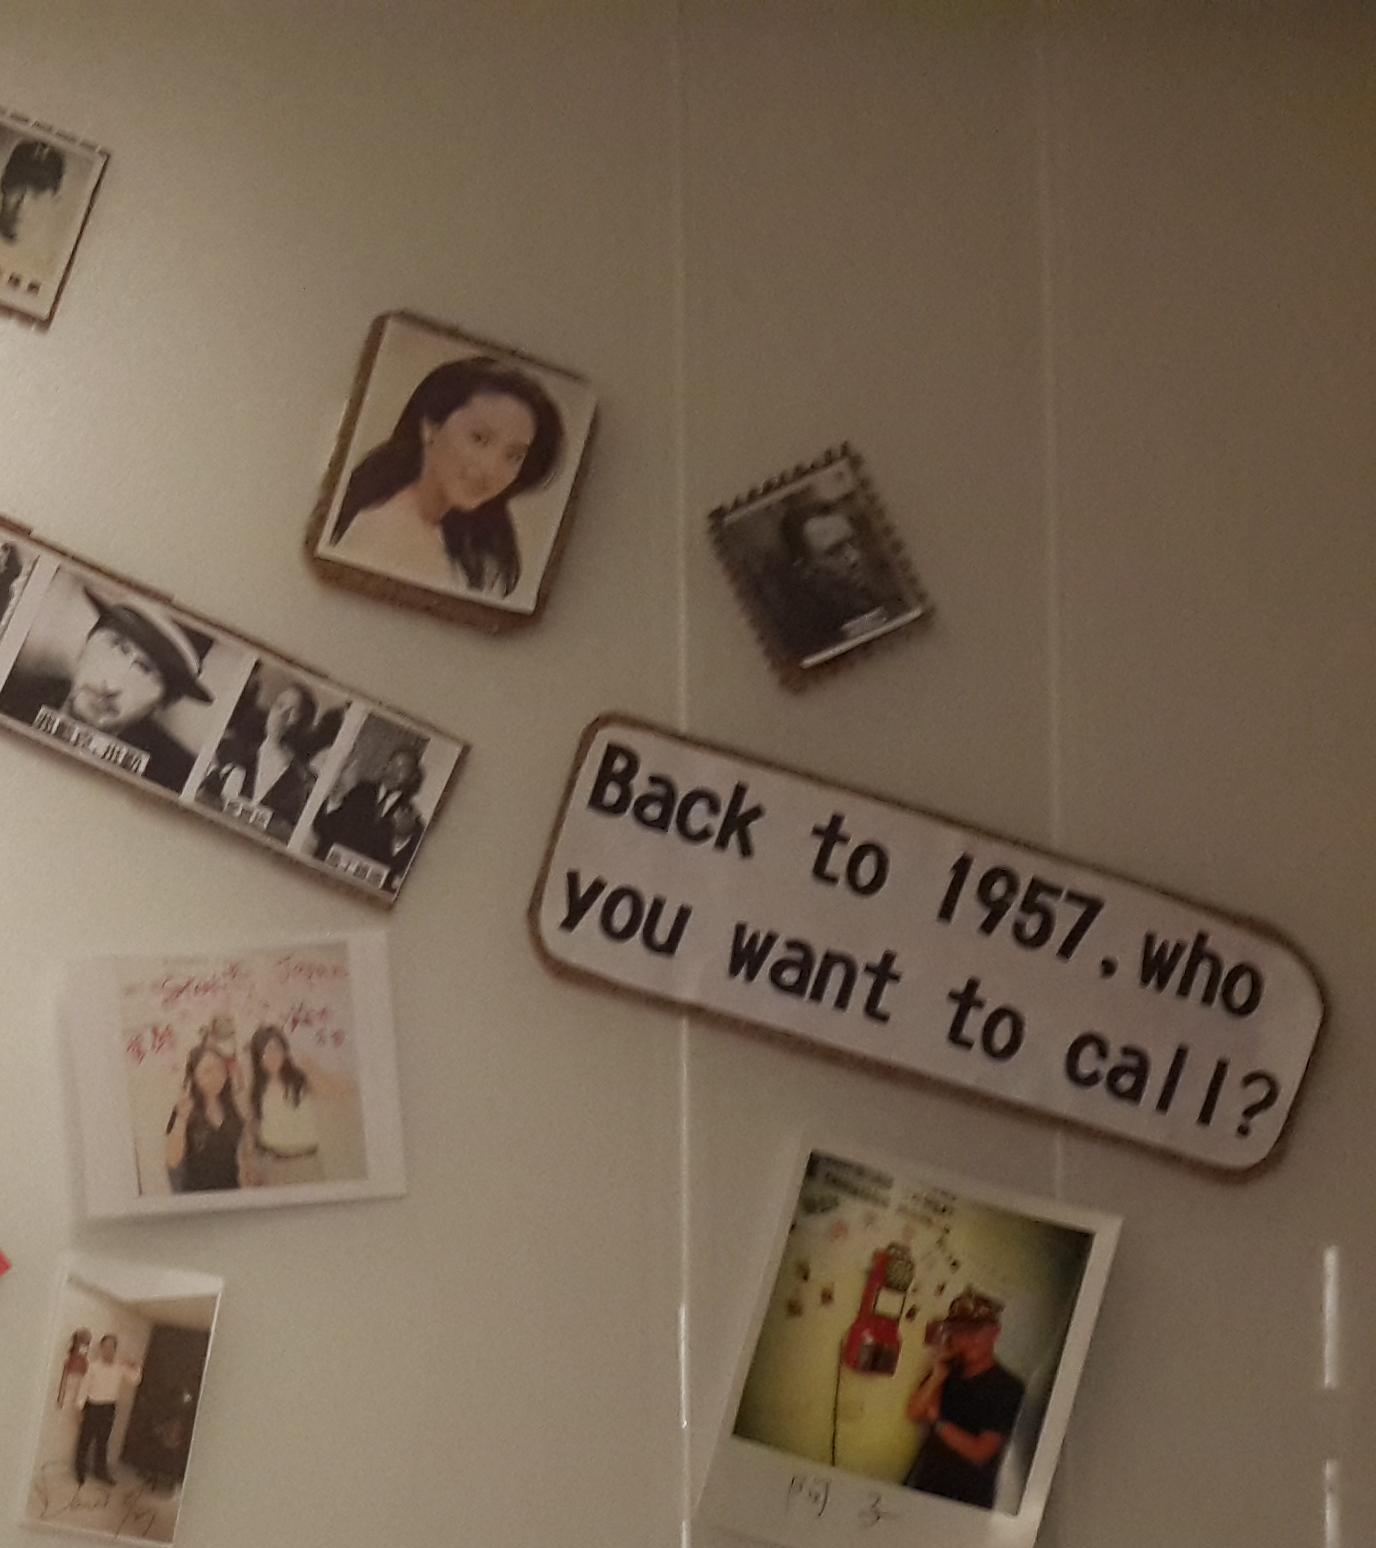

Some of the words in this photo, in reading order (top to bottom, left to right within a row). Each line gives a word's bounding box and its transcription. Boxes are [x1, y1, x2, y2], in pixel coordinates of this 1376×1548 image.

[586, 742, 765, 859] Back
[811, 812, 890, 897] to
[558, 869, 693, 957] you
[727, 920, 902, 1024] want
[947, 976, 1027, 1062] to
[1064, 1029, 1280, 1139] call?
